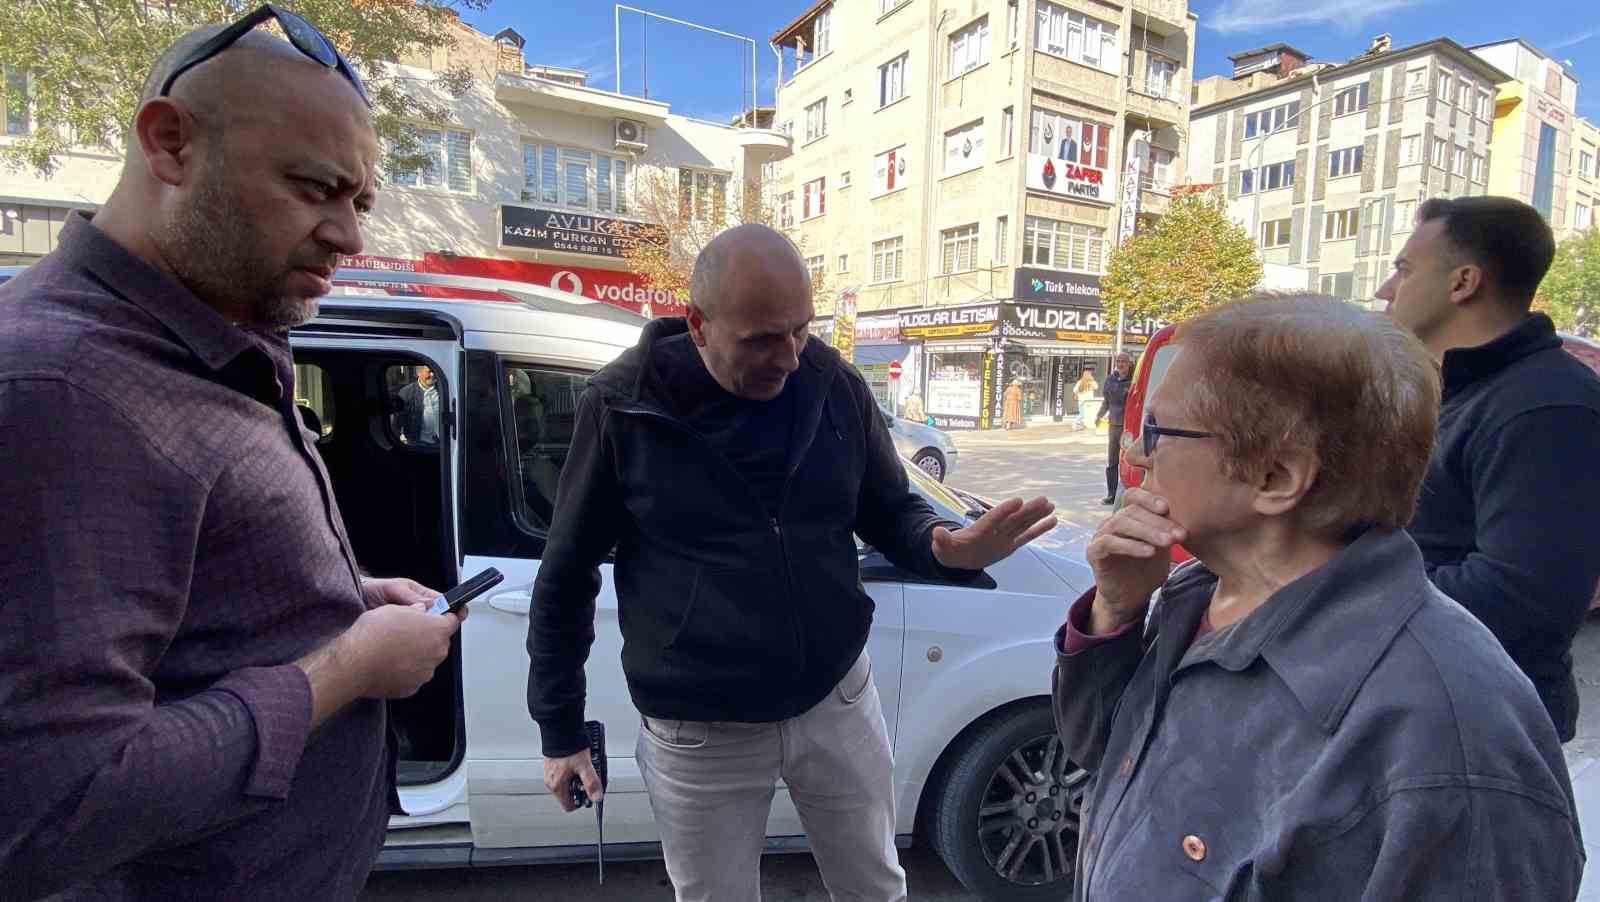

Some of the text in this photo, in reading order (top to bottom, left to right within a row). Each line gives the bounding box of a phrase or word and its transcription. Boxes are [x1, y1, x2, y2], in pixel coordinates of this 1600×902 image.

[1065, 163, 1103, 184] ZAFER
[553, 231, 607, 245] FURKAN
[1044, 279, 1100, 297] Türk Telekom
